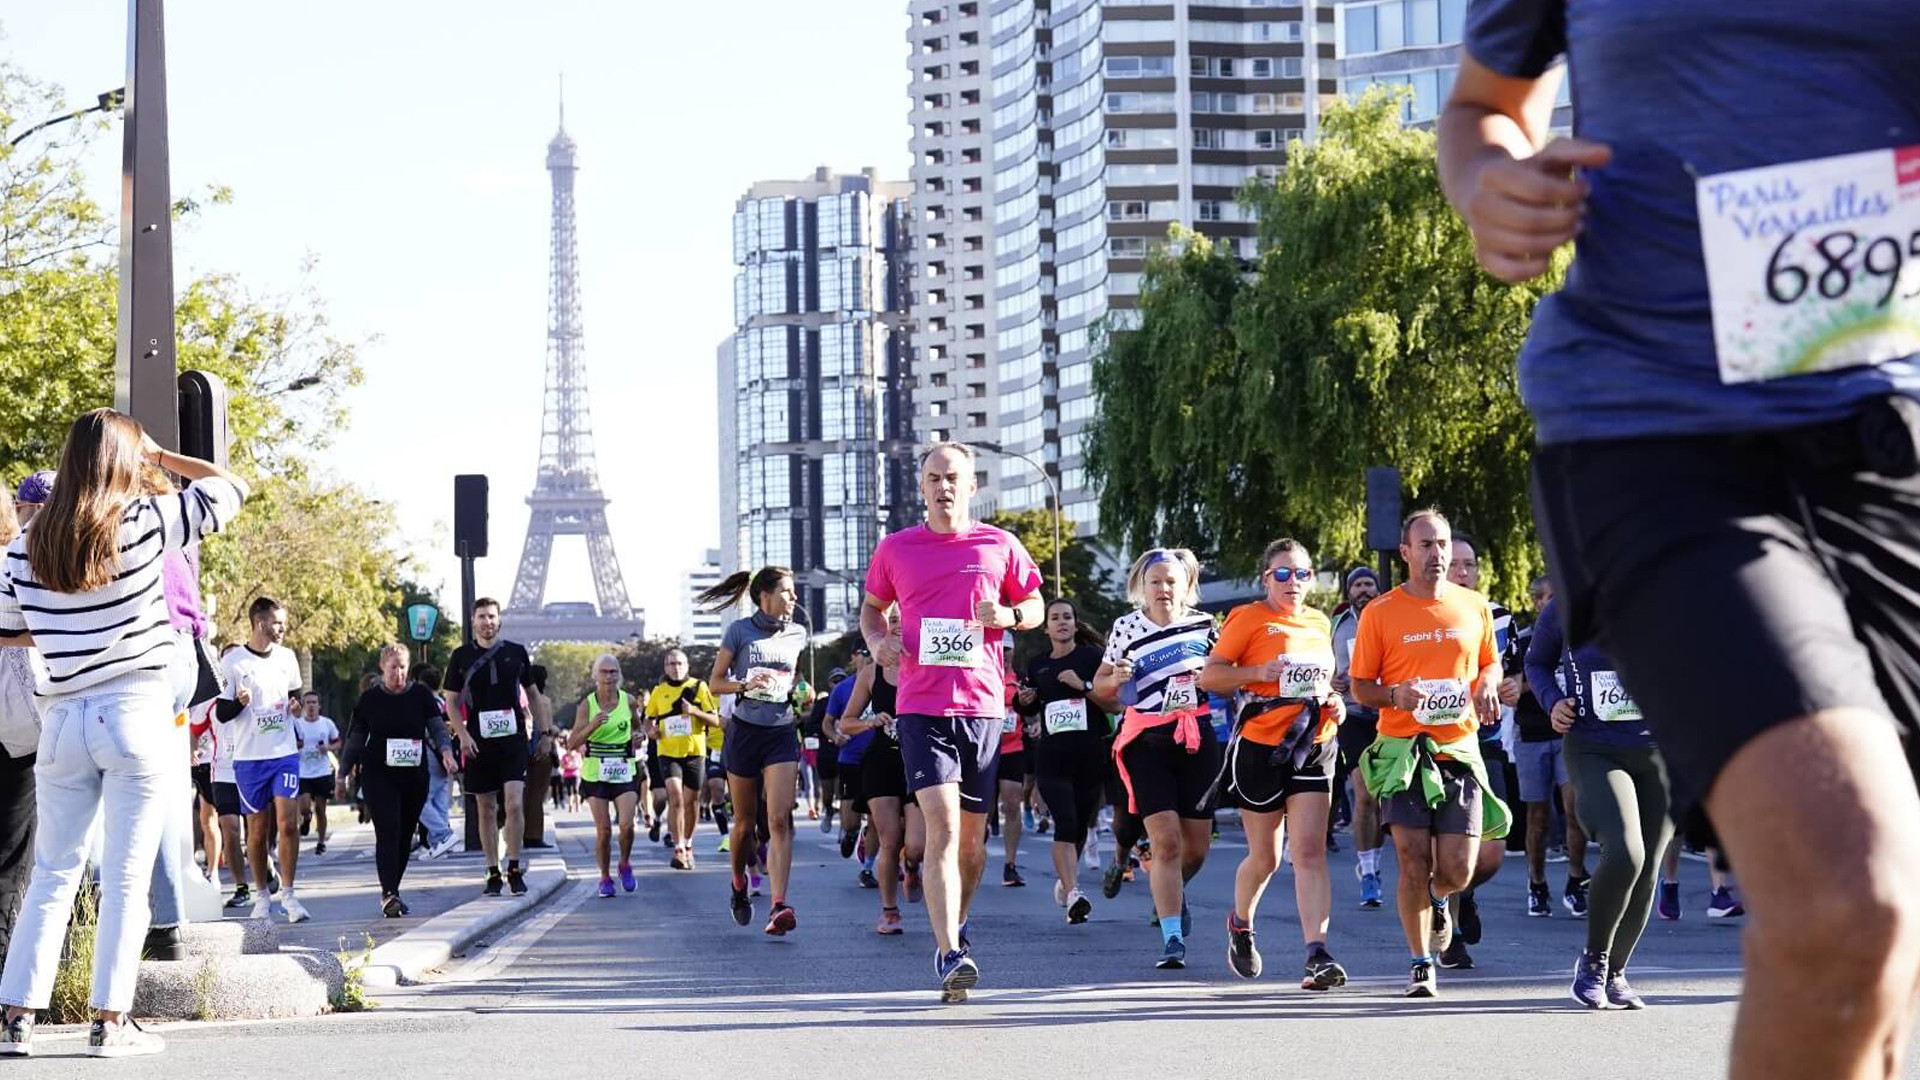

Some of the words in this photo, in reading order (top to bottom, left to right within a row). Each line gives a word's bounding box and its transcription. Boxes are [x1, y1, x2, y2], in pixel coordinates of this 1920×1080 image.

[1708, 178, 1802, 217] Paris
[1732, 181, 1892, 242] Versailles
[924, 633, 974, 655] 3366
[1420, 690, 1466, 711] 16026
[256, 713, 284, 728] 13302
[487, 719, 510, 730] 8519
[1049, 709, 1082, 726] 17594
[282, 772, 298, 789] 10
